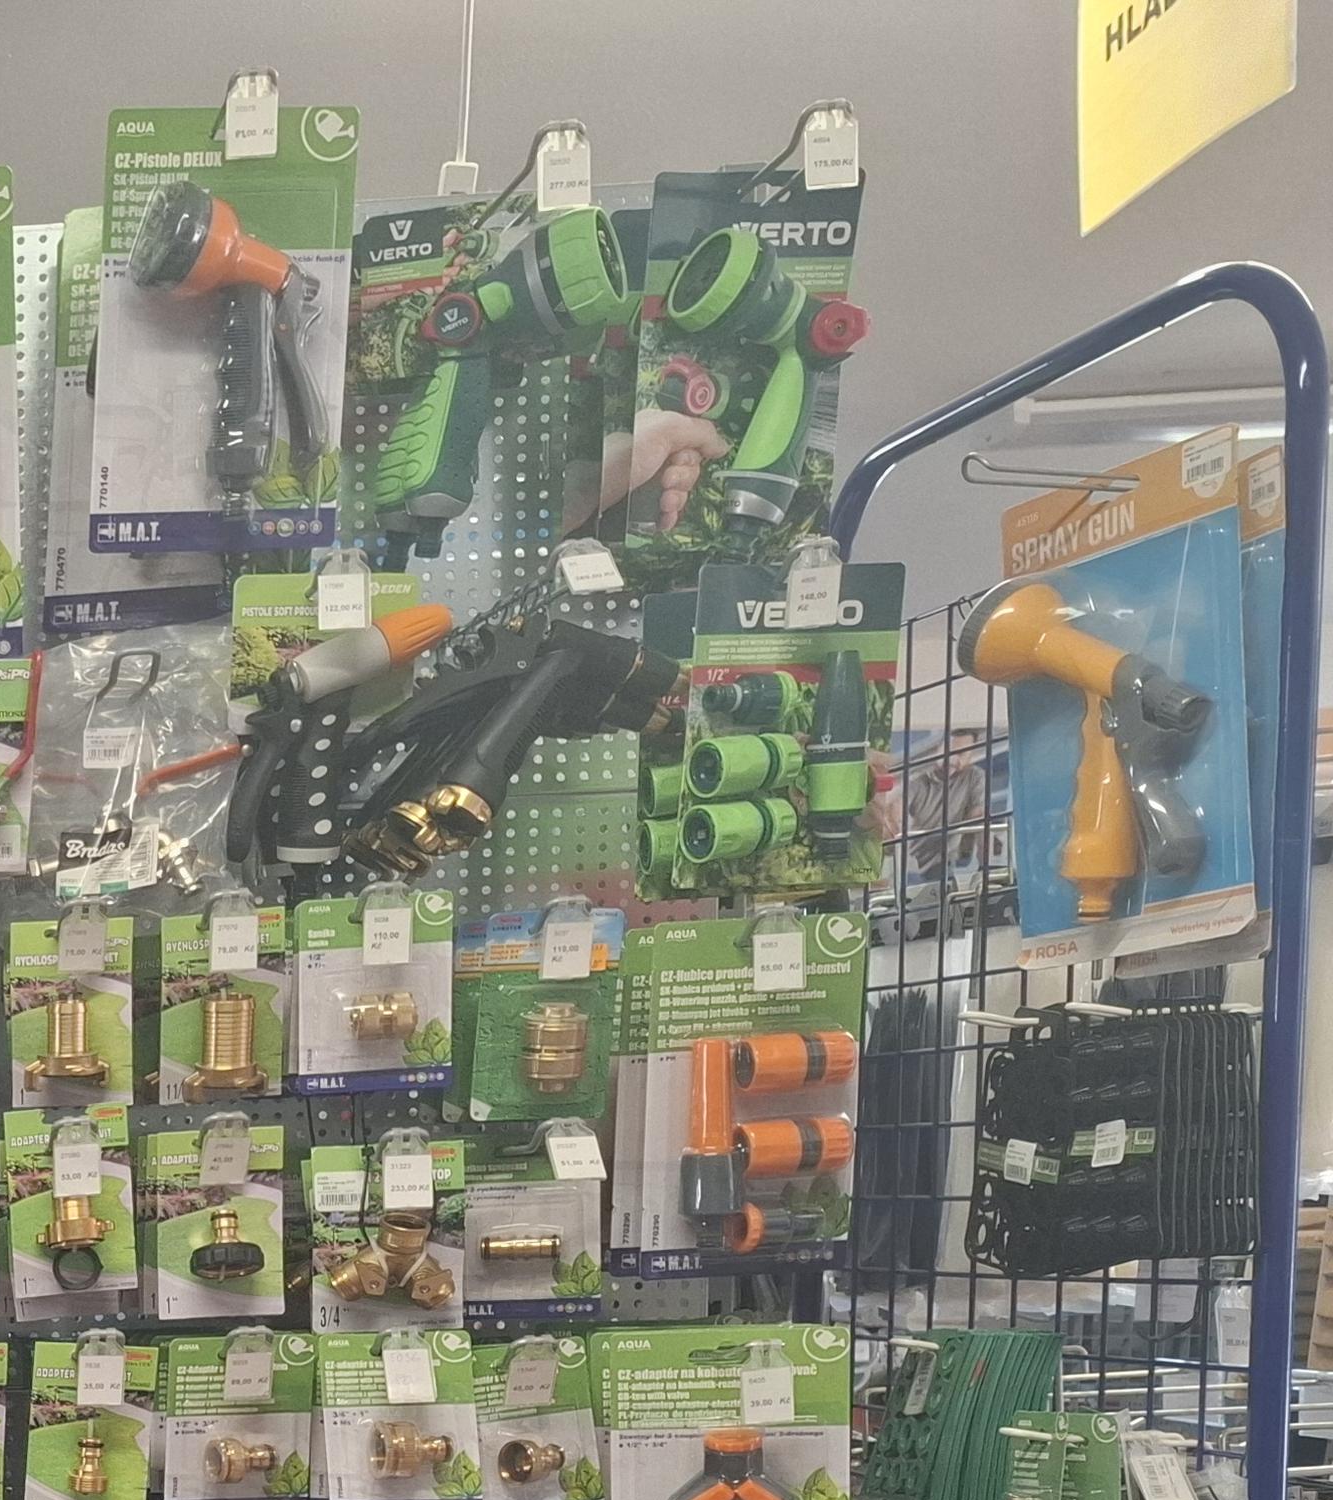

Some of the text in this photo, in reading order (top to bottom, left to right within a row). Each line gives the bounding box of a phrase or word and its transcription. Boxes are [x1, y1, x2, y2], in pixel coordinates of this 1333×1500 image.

[115, 121, 156, 138] AQUA
[114, 151, 223, 170] CZ-Pistole DELUX
[370, 243, 433, 262] VERTO
[439, 317, 471, 336] VERTO
[100, 467, 110, 508] 770140
[118, 521, 162, 544] M.A.T.
[1011, 500, 1136, 576] SPRAY GUN
[76, 602, 122, 623] M.A.T.
[736, 600, 864, 627] VEO
[65, 836, 127, 860] Bradas
[666, 928, 698, 941] AQUA
[1036, 941, 1079, 962] ROSA
[10, 1132, 50, 1149] ADAPTER
[649, 1206, 659, 1248] 770290
[617, 1340, 652, 1352] AQUA
[36, 1365, 76, 1382] ADAPTER
